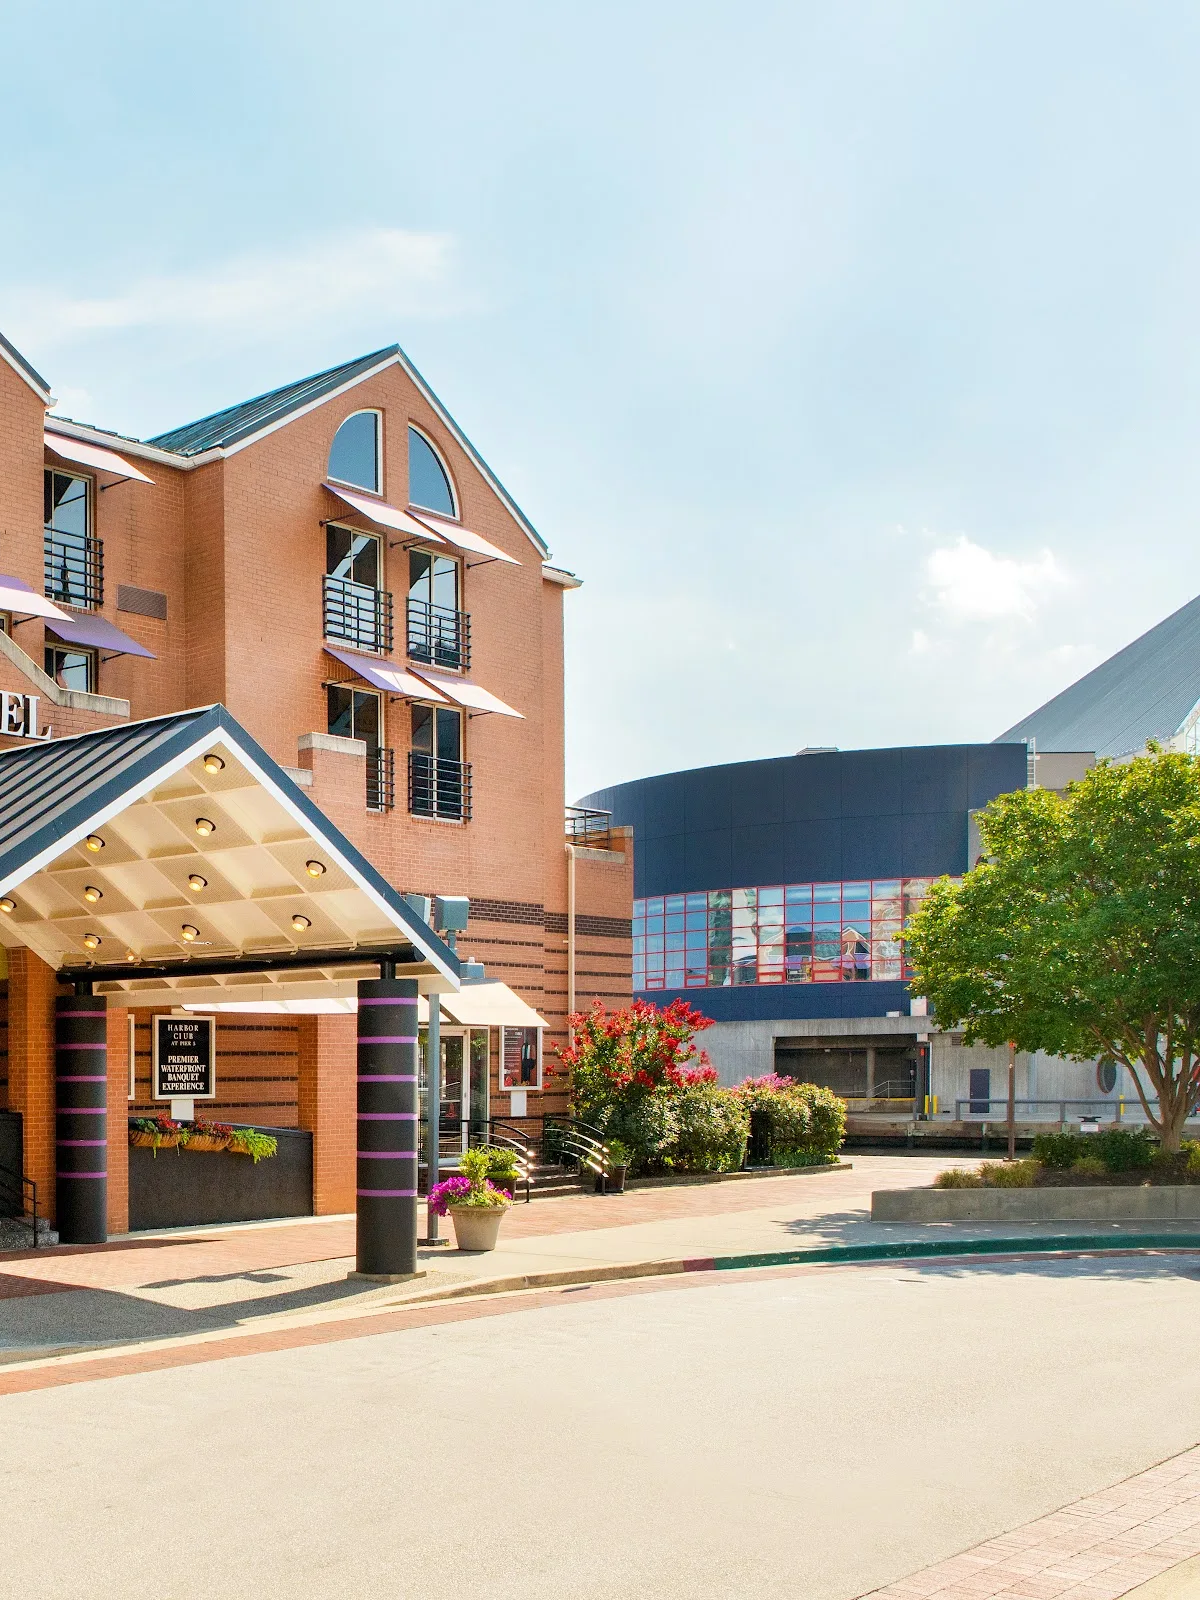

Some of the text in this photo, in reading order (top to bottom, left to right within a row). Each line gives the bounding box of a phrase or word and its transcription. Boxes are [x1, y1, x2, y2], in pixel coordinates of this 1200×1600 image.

[167, 1024, 199, 1032] HARBOR
[173, 1032, 194, 1040] CLUB
[168, 1055, 199, 1063] PREMIER
[161, 1064, 206, 1073] WATERFRONT
[167, 1073, 199, 1082] BANQUET
[162, 1082, 205, 1091] EXPERIENCE
